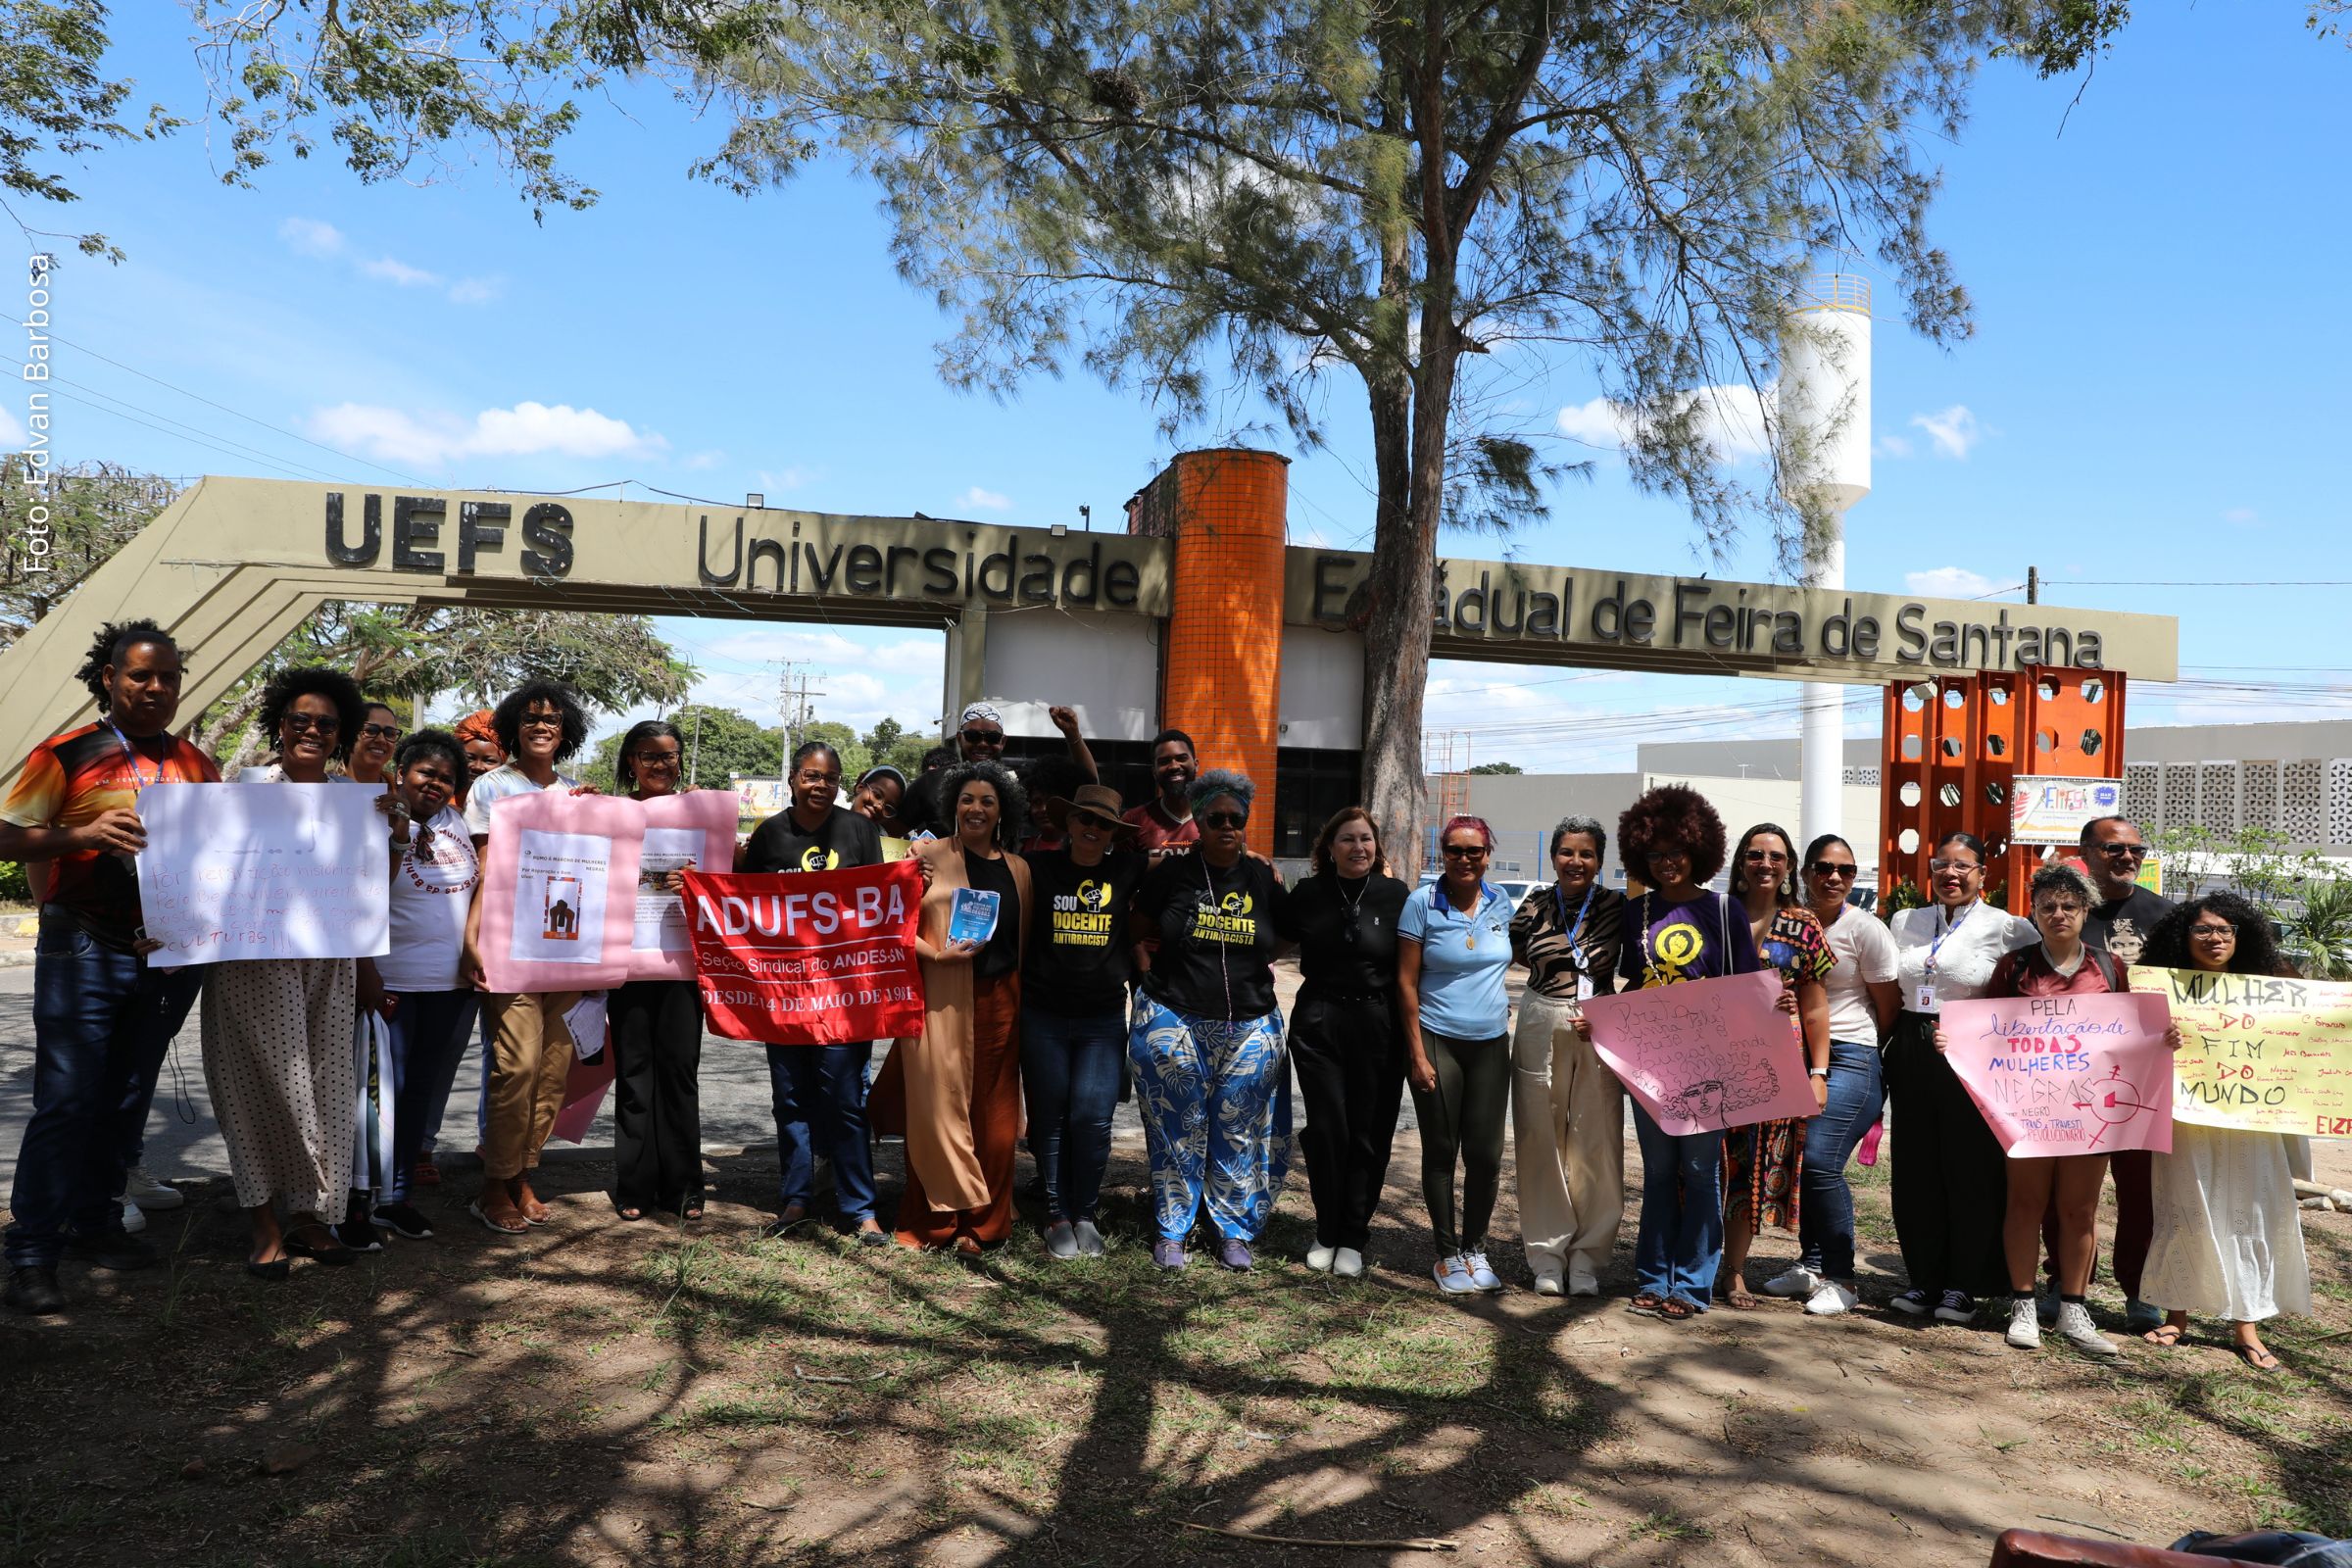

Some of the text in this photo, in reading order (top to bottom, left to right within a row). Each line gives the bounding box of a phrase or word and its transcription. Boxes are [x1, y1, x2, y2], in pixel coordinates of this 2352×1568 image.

[325, 492, 574, 577] UEFS
[699, 514, 2105, 668] Universidade Eadual de Feira de Santana
[149, 863, 186, 890] Por
[697, 883, 905, 937] ADUFS-BA
[1054, 895, 1078, 911] SOU
[1053, 911, 1112, 931] DOCENTE
[1198, 913, 1255, 934] DOCENTE
[1053, 932, 1109, 947] ANTIRRACISTA
[748, 957, 807, 974] Sindical
[811, 959, 830, 972] do
[833, 948, 906, 969] ANDES-SN
[703, 990, 759, 1006] DESDE
[781, 997, 806, 1012] DE
[808, 993, 855, 1012] MAIO
[858, 988, 882, 1005] DE
[885, 985, 912, 1003] 1981
[2170, 973, 2308, 1007] MULHER
[2031, 998, 2078, 1017] PELA
[1980, 1013, 2132, 1041] libertação de
[2218, 1012, 2256, 1030] DO
[2007, 1034, 2082, 1054] TODAS
[2201, 1035, 2266, 1059] FIM
[1988, 1053, 2090, 1077] MULHERES
[2216, 1061, 2255, 1081] DO
[1994, 1077, 2097, 1105] NEGRAS
[2180, 1081, 2286, 1105] MUNDO
[2022, 1106, 2051, 1117] NEGRO
